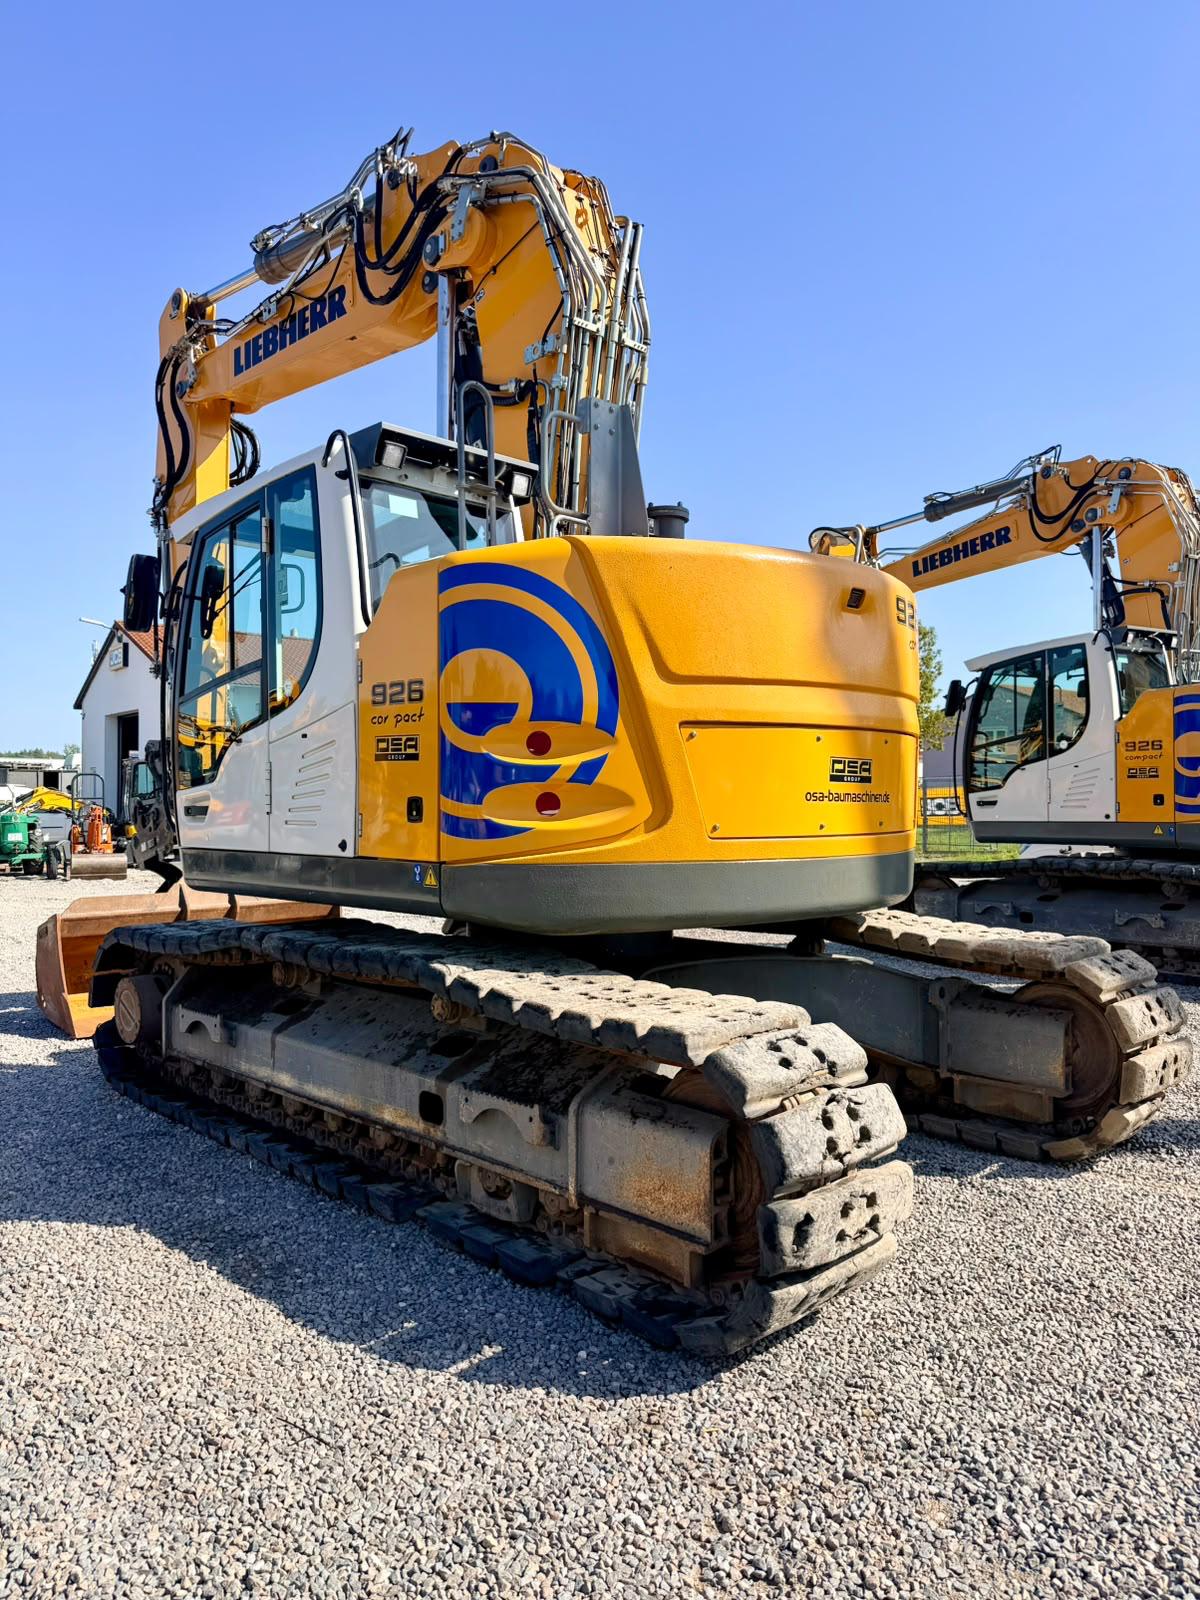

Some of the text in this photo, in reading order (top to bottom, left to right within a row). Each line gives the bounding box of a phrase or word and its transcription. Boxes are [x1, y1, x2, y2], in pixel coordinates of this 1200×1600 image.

[234, 285, 347, 377] LIEBHERR
[912, 526, 1012, 577] LIEBHERR
[896, 595, 917, 630] 92
[371, 679, 423, 705] 926
[376, 736, 418, 753] OSA
[1125, 740, 1163, 753] 926
[1125, 752, 1163, 762] compact
[832, 759, 871, 775] OSA
[805, 790, 890, 803] osa-baumaschinen.de
